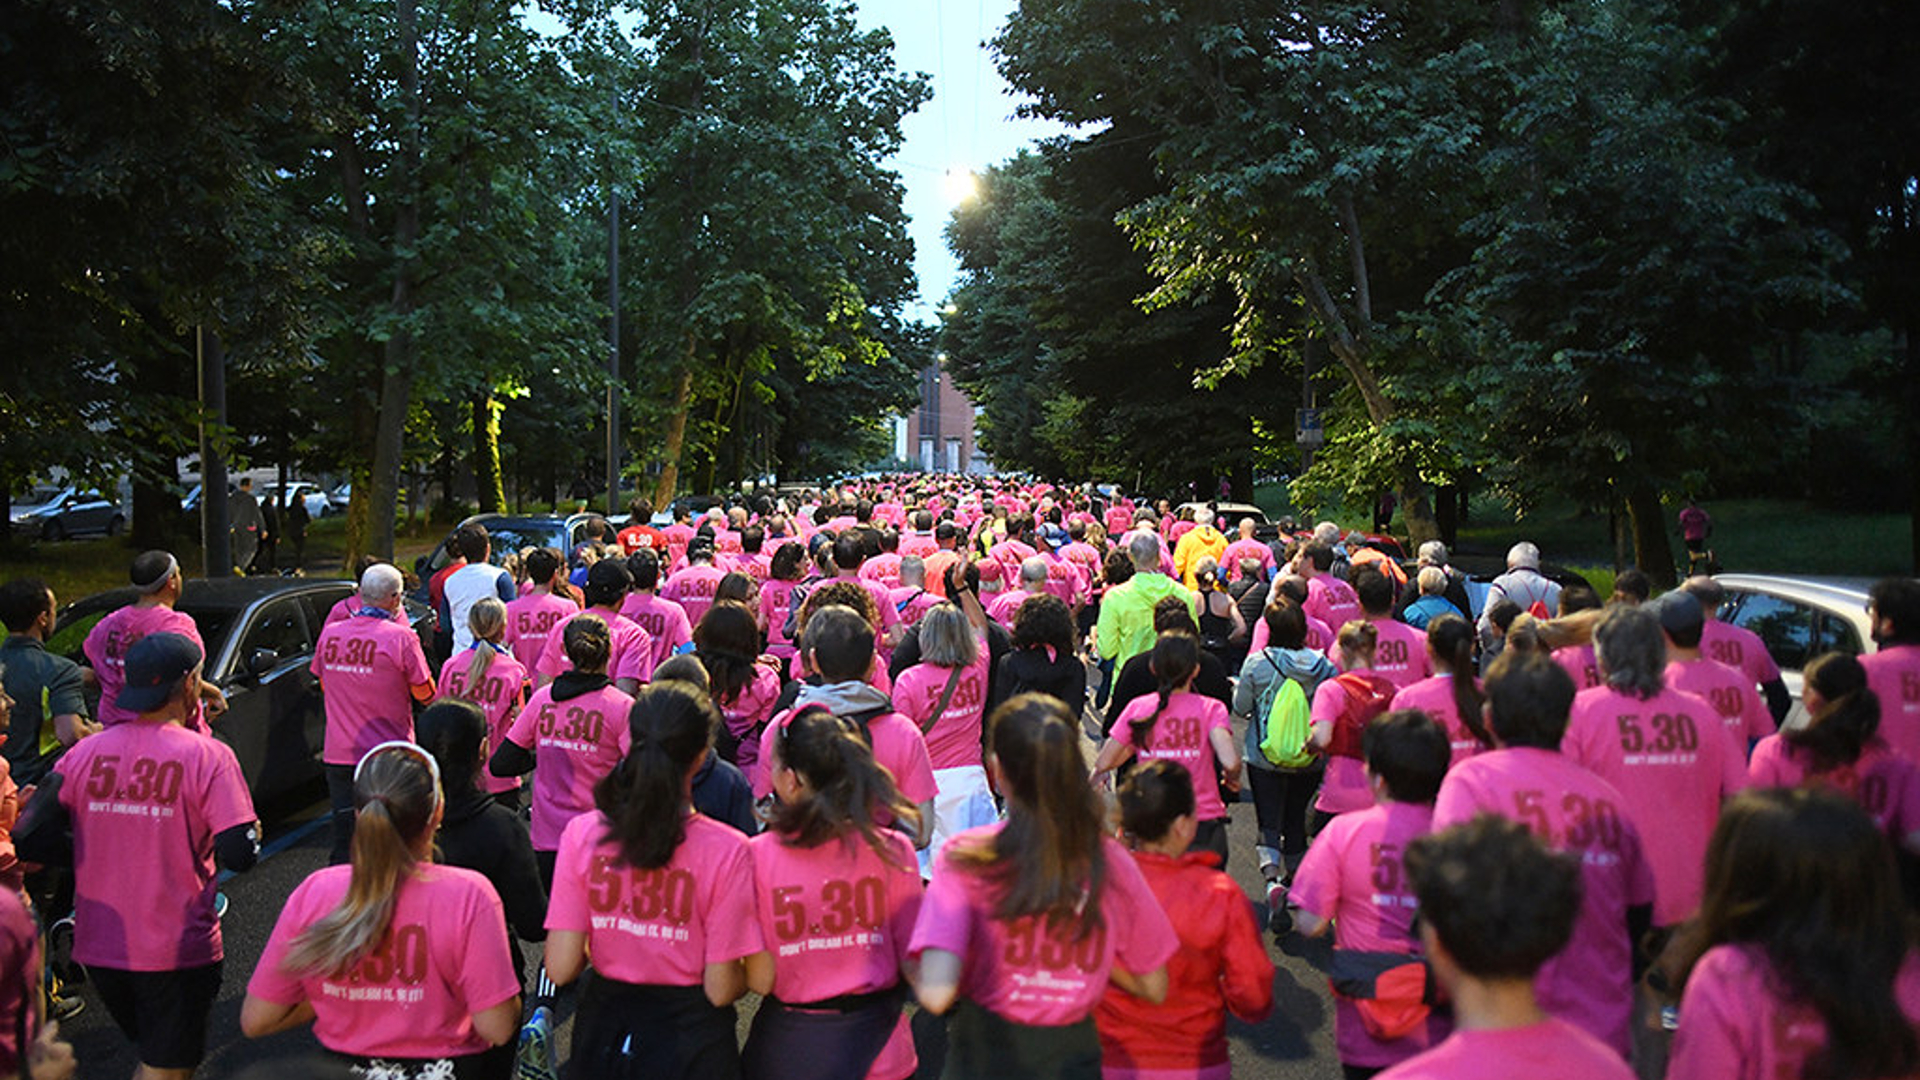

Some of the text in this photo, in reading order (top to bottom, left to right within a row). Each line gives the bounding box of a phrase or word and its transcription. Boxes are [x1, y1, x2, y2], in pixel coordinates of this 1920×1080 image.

[627, 534, 653, 547] 5.30
[877, 565, 899, 578] 5.3
[1049, 564, 1068, 579] 30
[680, 578, 719, 597] 5.30
[324, 637, 377, 666] 5.30
[1376, 640, 1408, 664] .30
[1710, 640, 1743, 666] 30
[1710, 686, 1743, 717] 30
[540, 703, 604, 744] 5.30
[1146, 717, 1201, 749] .30
[1617, 713, 1698, 753] 5.30
[87, 756, 184, 805] 5.30
[588, 856, 696, 927] 5.30
[772, 876, 885, 942] 5.30
[330, 924, 428, 987] .30
[780, 941, 806, 957] DON'T
